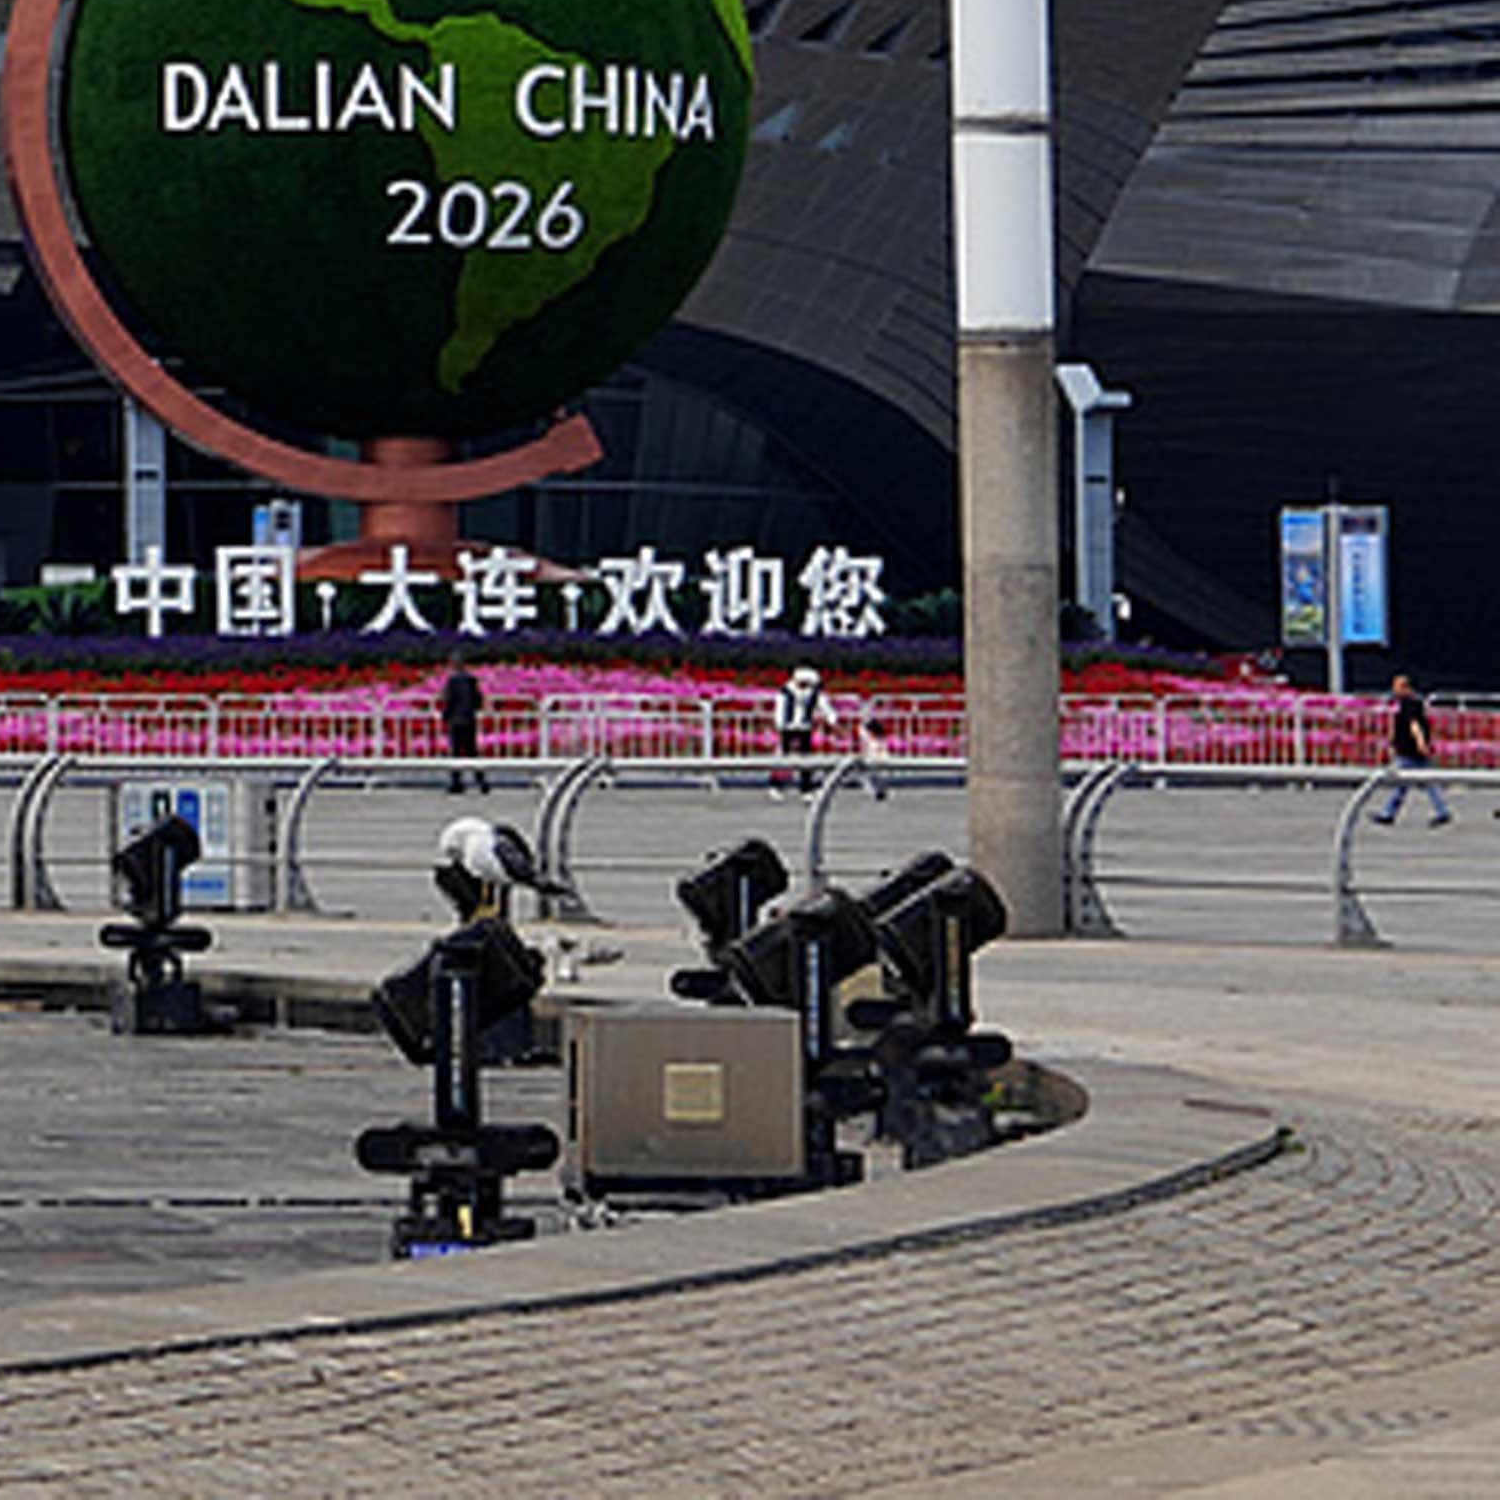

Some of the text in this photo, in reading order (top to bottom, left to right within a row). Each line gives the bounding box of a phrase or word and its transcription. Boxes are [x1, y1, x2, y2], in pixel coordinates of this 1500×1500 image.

[163, 61, 715, 141] DALIAN CHINA
[386, 181, 584, 249] 2026
